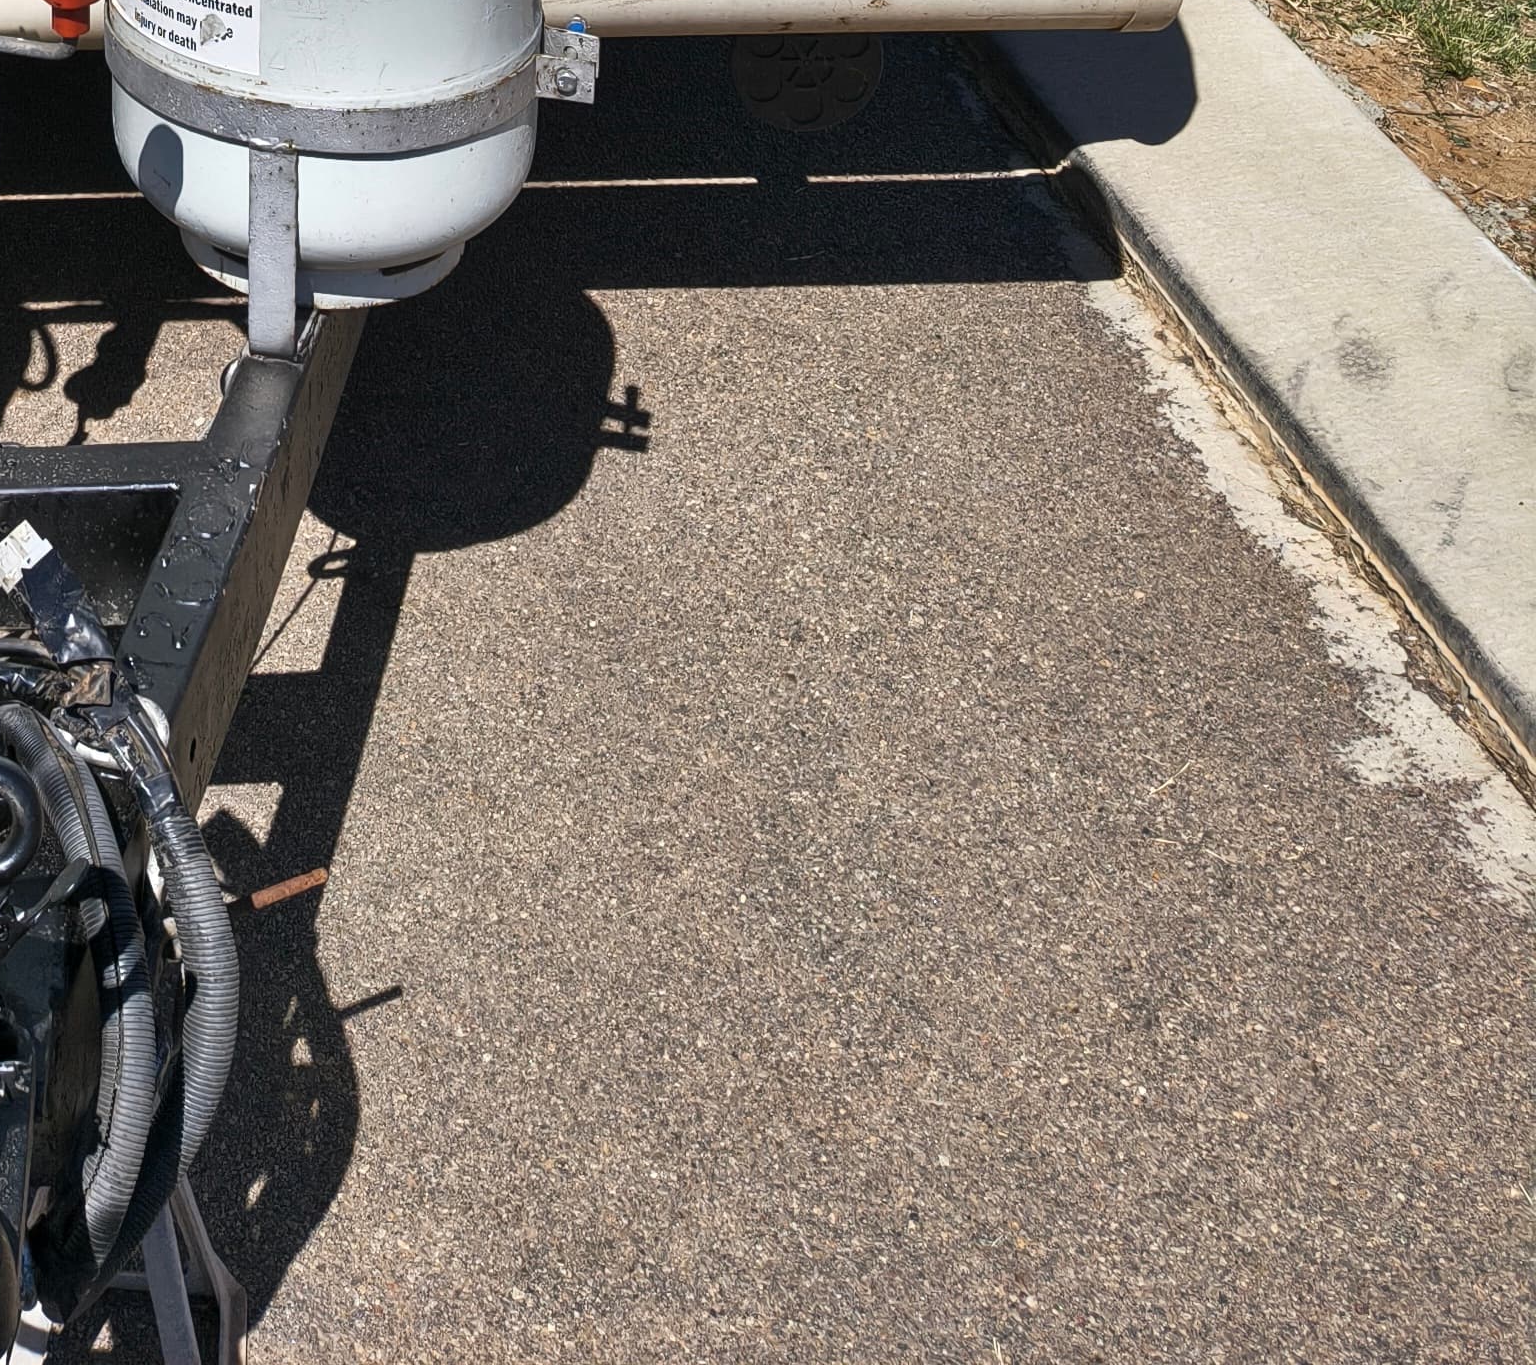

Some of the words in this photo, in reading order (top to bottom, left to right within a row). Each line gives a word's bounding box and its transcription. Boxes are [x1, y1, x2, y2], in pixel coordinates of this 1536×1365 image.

[176, 11, 198, 31] may
[157, 26, 167, 38] or
[168, 29, 197, 52] death
